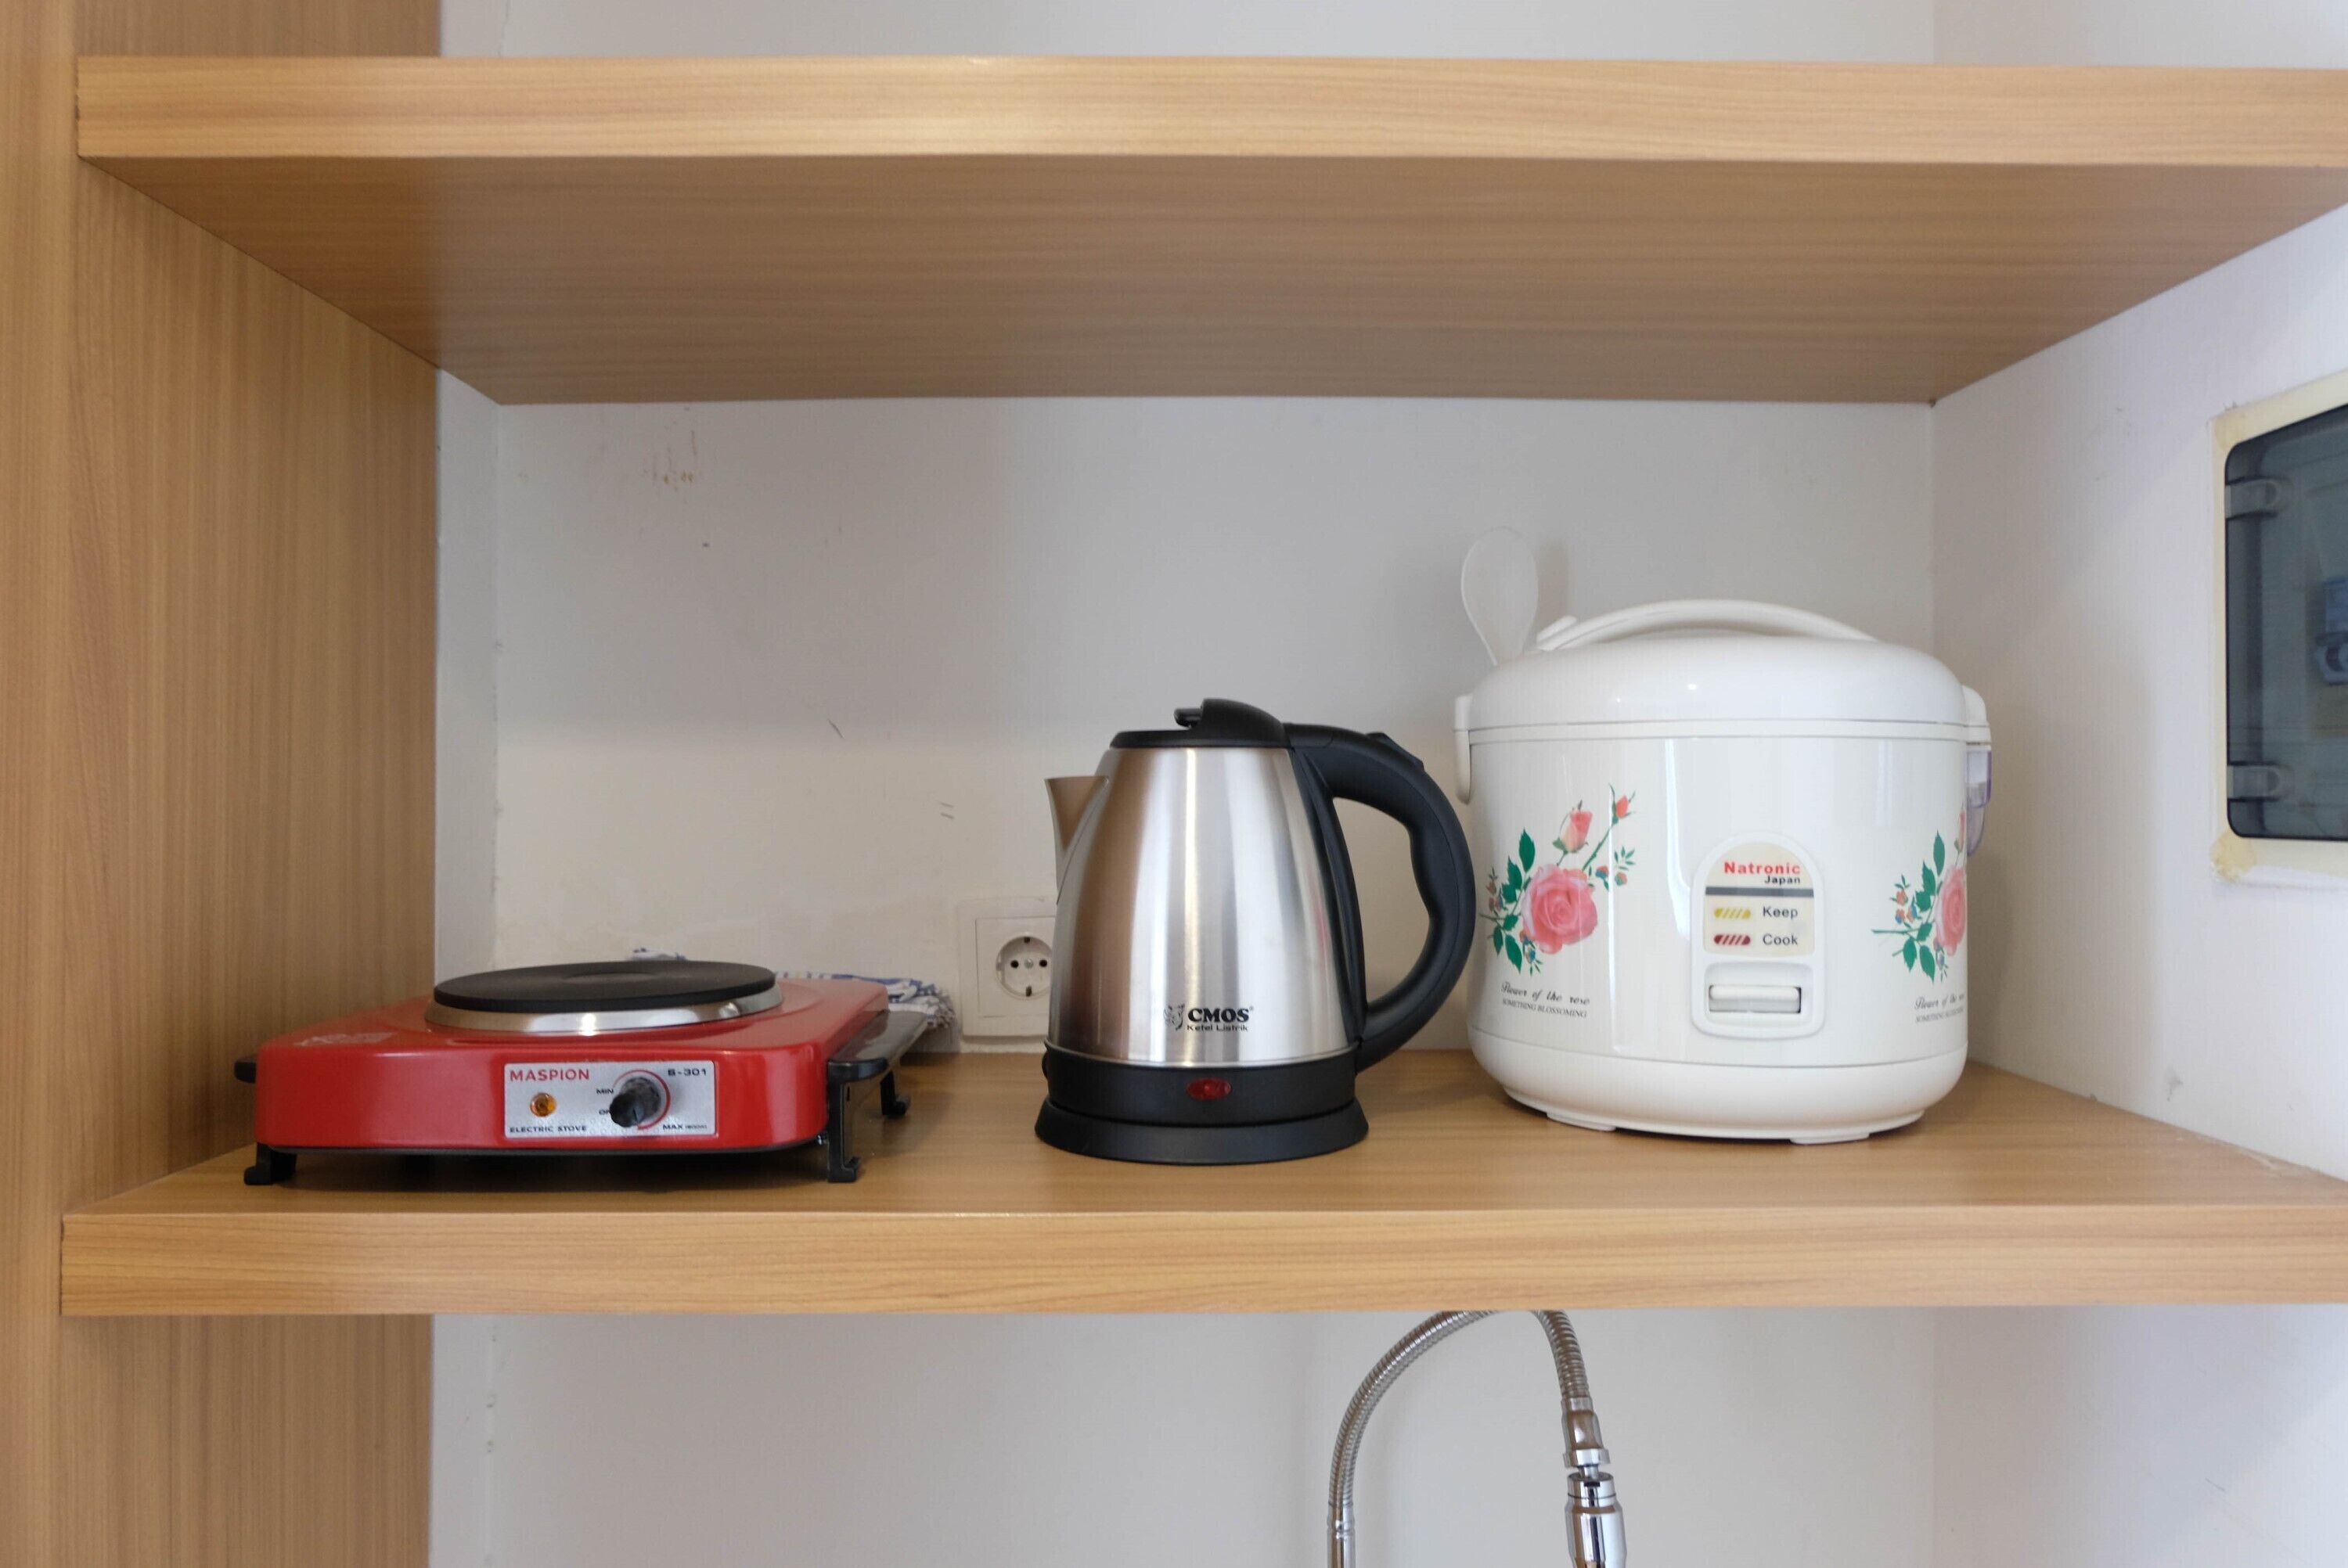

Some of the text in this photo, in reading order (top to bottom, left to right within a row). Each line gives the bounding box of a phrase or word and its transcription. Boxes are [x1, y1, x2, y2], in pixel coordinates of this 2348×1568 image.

[1723, 861, 1801, 876] Natronic
[1764, 876, 1801, 885] Japan
[1763, 906, 1799, 919] Keep
[1763, 933, 1799, 945] Cook
[1187, 1008, 1250, 1023] CMOS
[510, 1069, 589, 1082] MASPION
